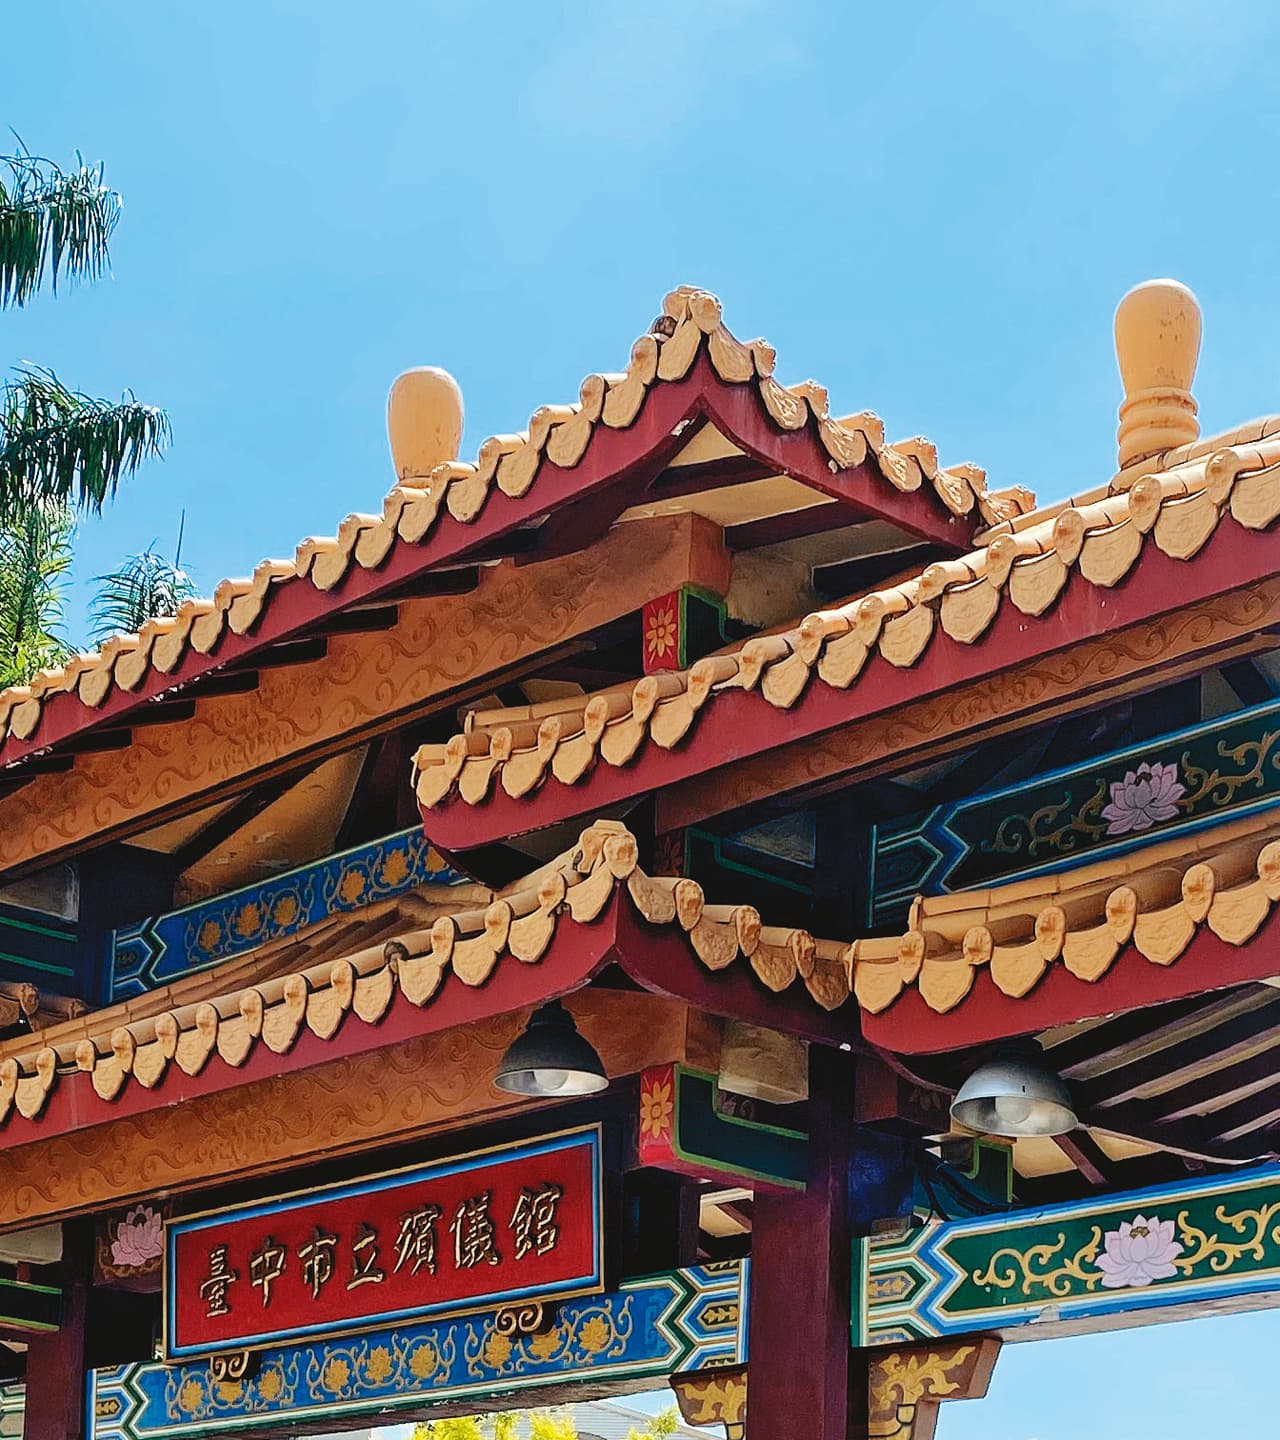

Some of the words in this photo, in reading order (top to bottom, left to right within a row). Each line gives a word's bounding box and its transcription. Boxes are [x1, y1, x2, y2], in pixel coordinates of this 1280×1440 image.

[199, 1182, 566, 1318] 臺中市立殯儀館
